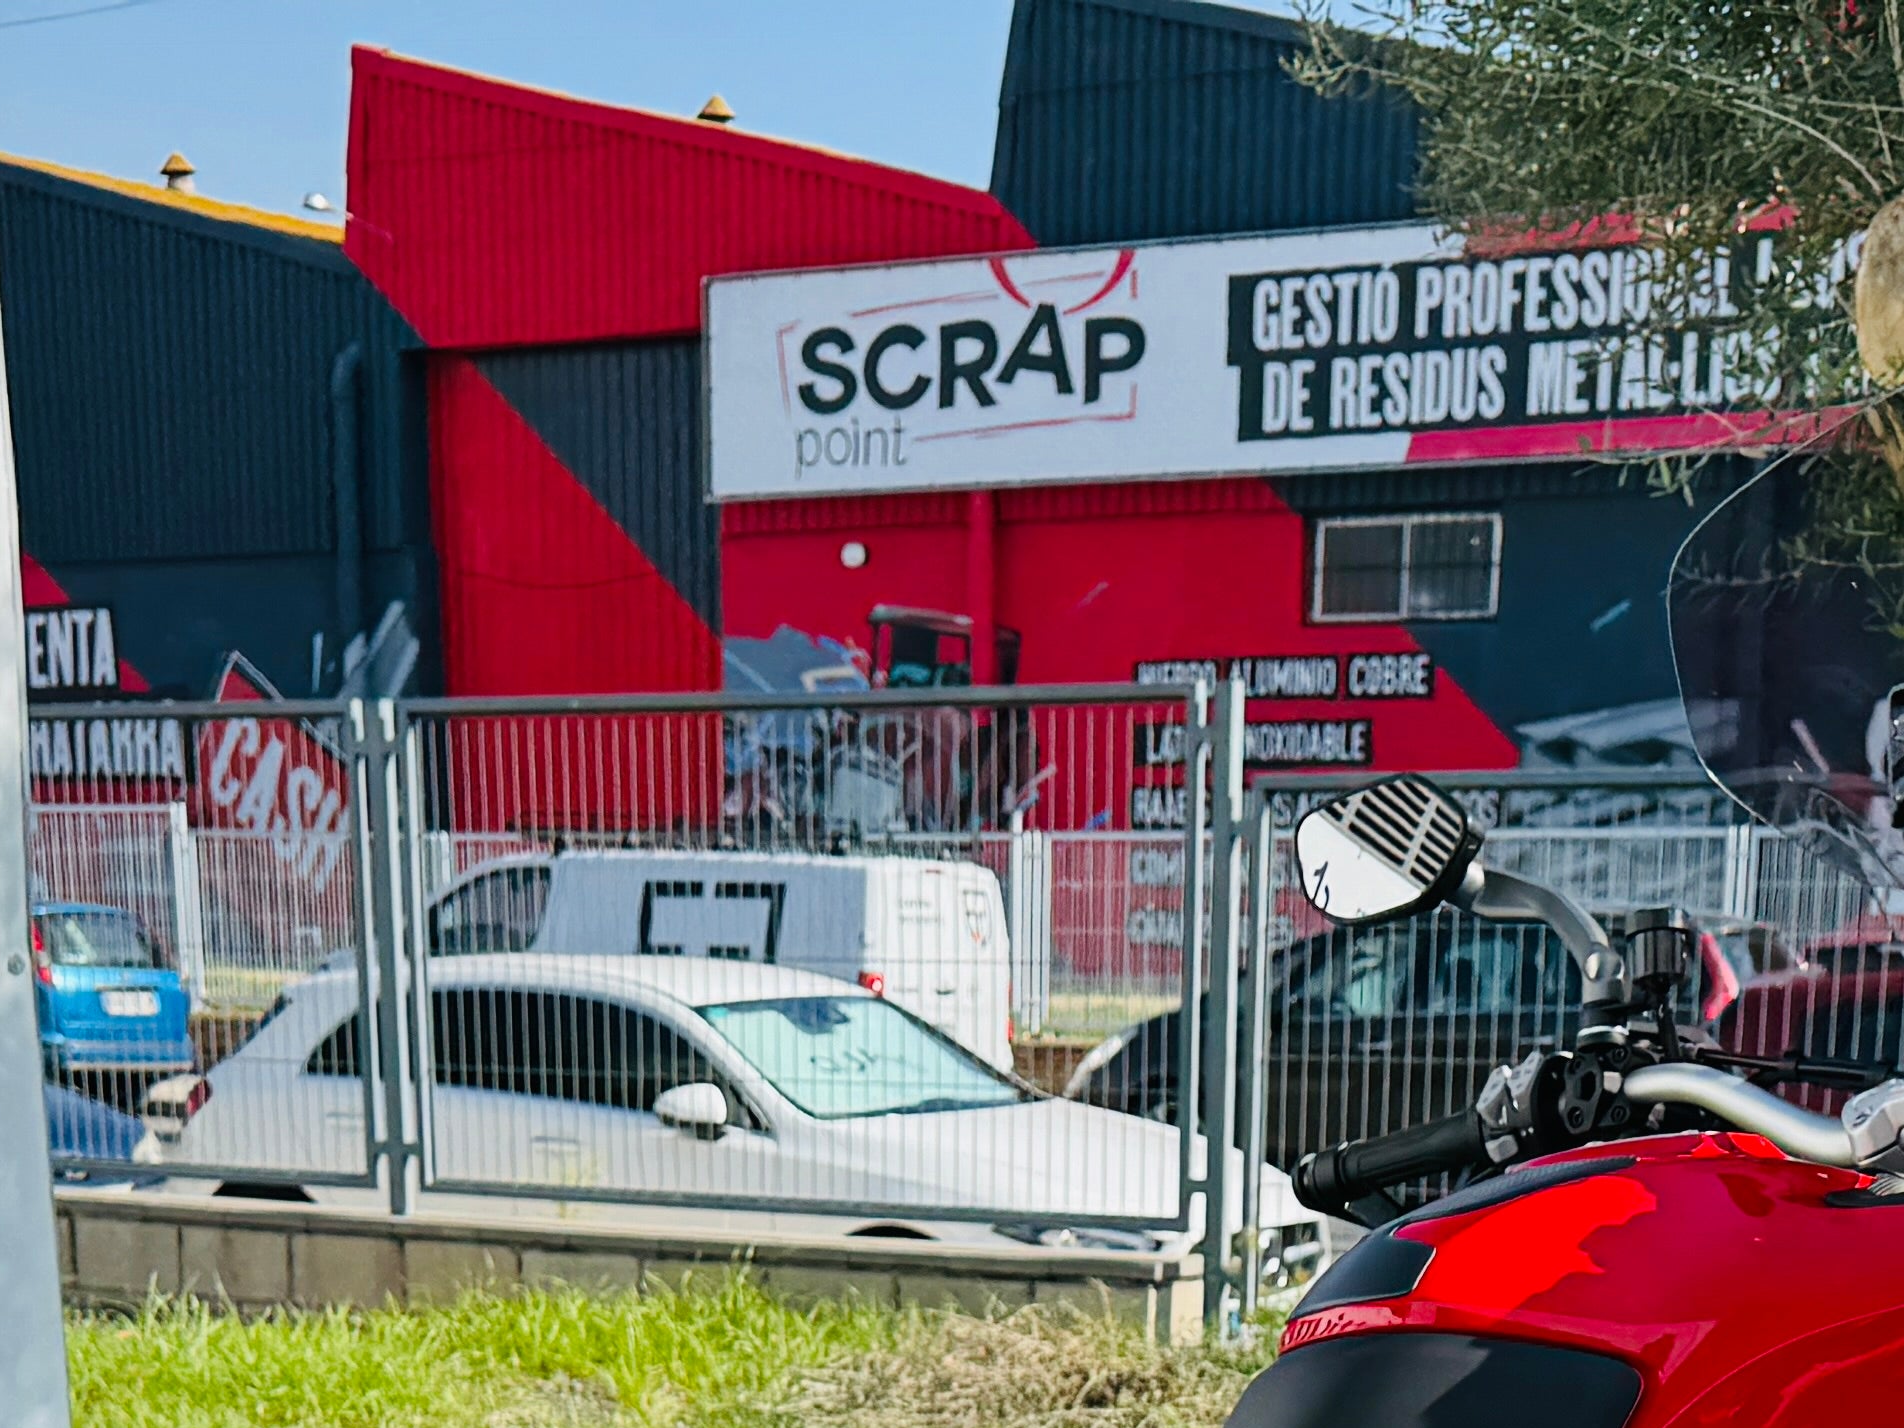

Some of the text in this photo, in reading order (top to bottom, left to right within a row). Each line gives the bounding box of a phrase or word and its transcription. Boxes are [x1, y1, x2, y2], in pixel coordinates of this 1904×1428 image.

[1252, 262, 1400, 351] GESTIÓ
[798, 303, 1146, 415] SCRAP
[1261, 359, 1317, 434] DE
[1328, 345, 1508, 429] RESIDUS
[795, 417, 908, 480] point
[1348, 653, 1431, 694] COBRE
[1245, 720, 1368, 764] NOXIDABLE
